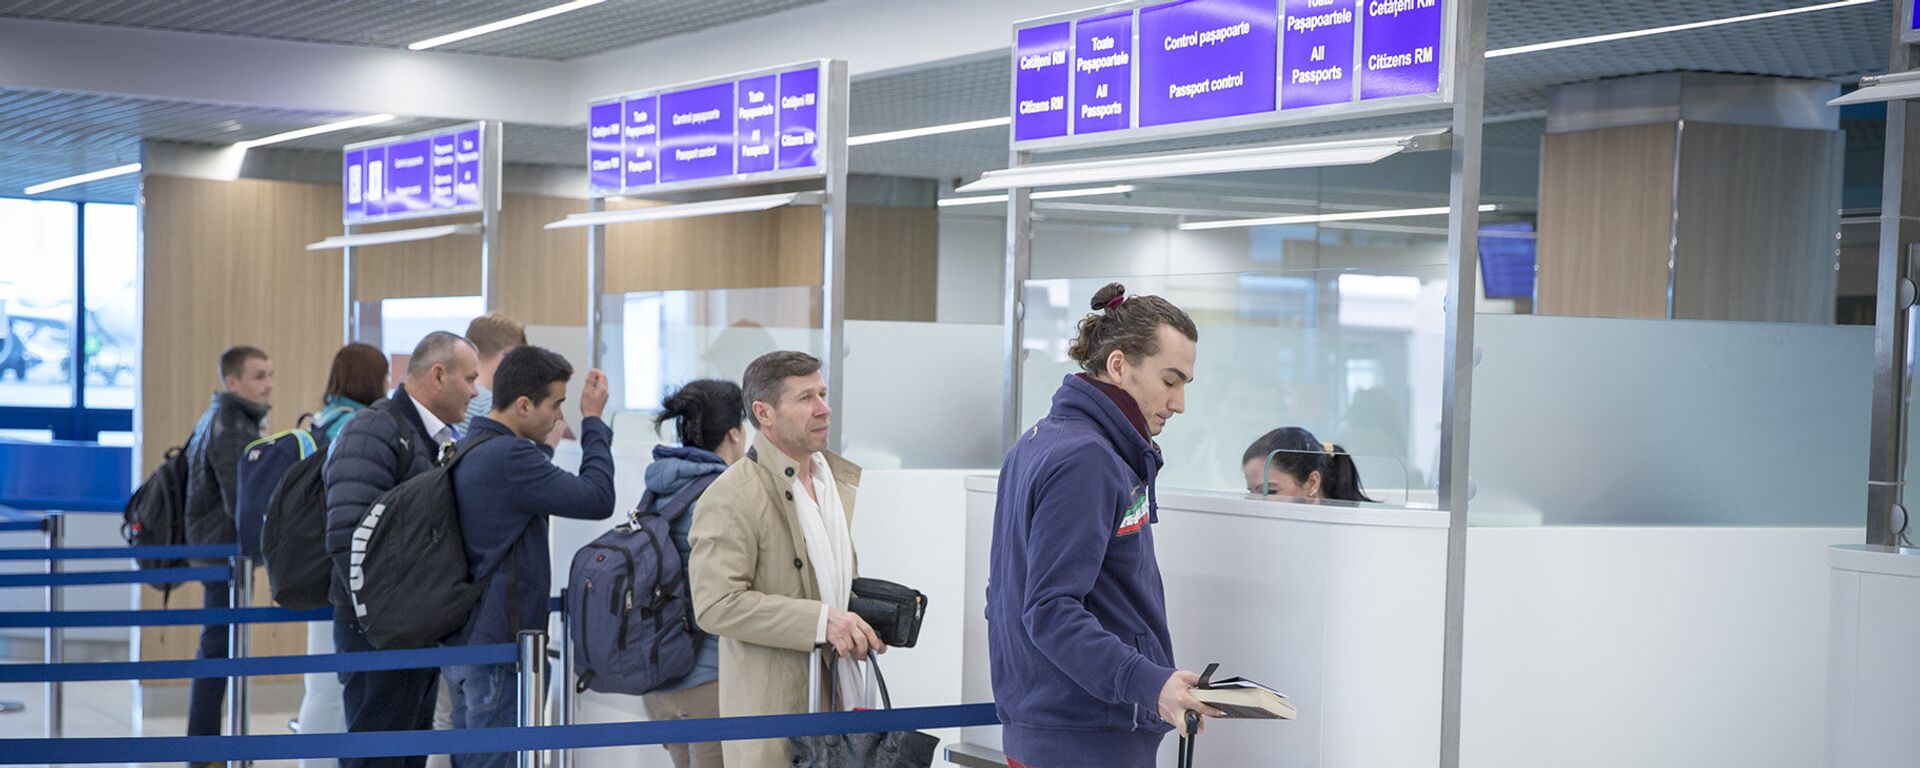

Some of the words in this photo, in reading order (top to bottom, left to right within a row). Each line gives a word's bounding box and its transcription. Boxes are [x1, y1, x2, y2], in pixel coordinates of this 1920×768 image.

[1091, 35, 1115, 51] Toate
[1164, 30, 1198, 51] Control
[1052, 49, 1066, 66] RM
[1310, 45, 1325, 62] All
[1368, 52, 1412, 71] Citizens
[1414, 46, 1433, 64] RM
[1291, 65, 1342, 85] Passports
[1095, 83, 1108, 99] All
[1169, 78, 1210, 99] Passport
[1210, 71, 1244, 91] control
[1019, 98, 1050, 115] Citizens
[1050, 95, 1064, 111] RM
[1081, 101, 1122, 119] Passports
